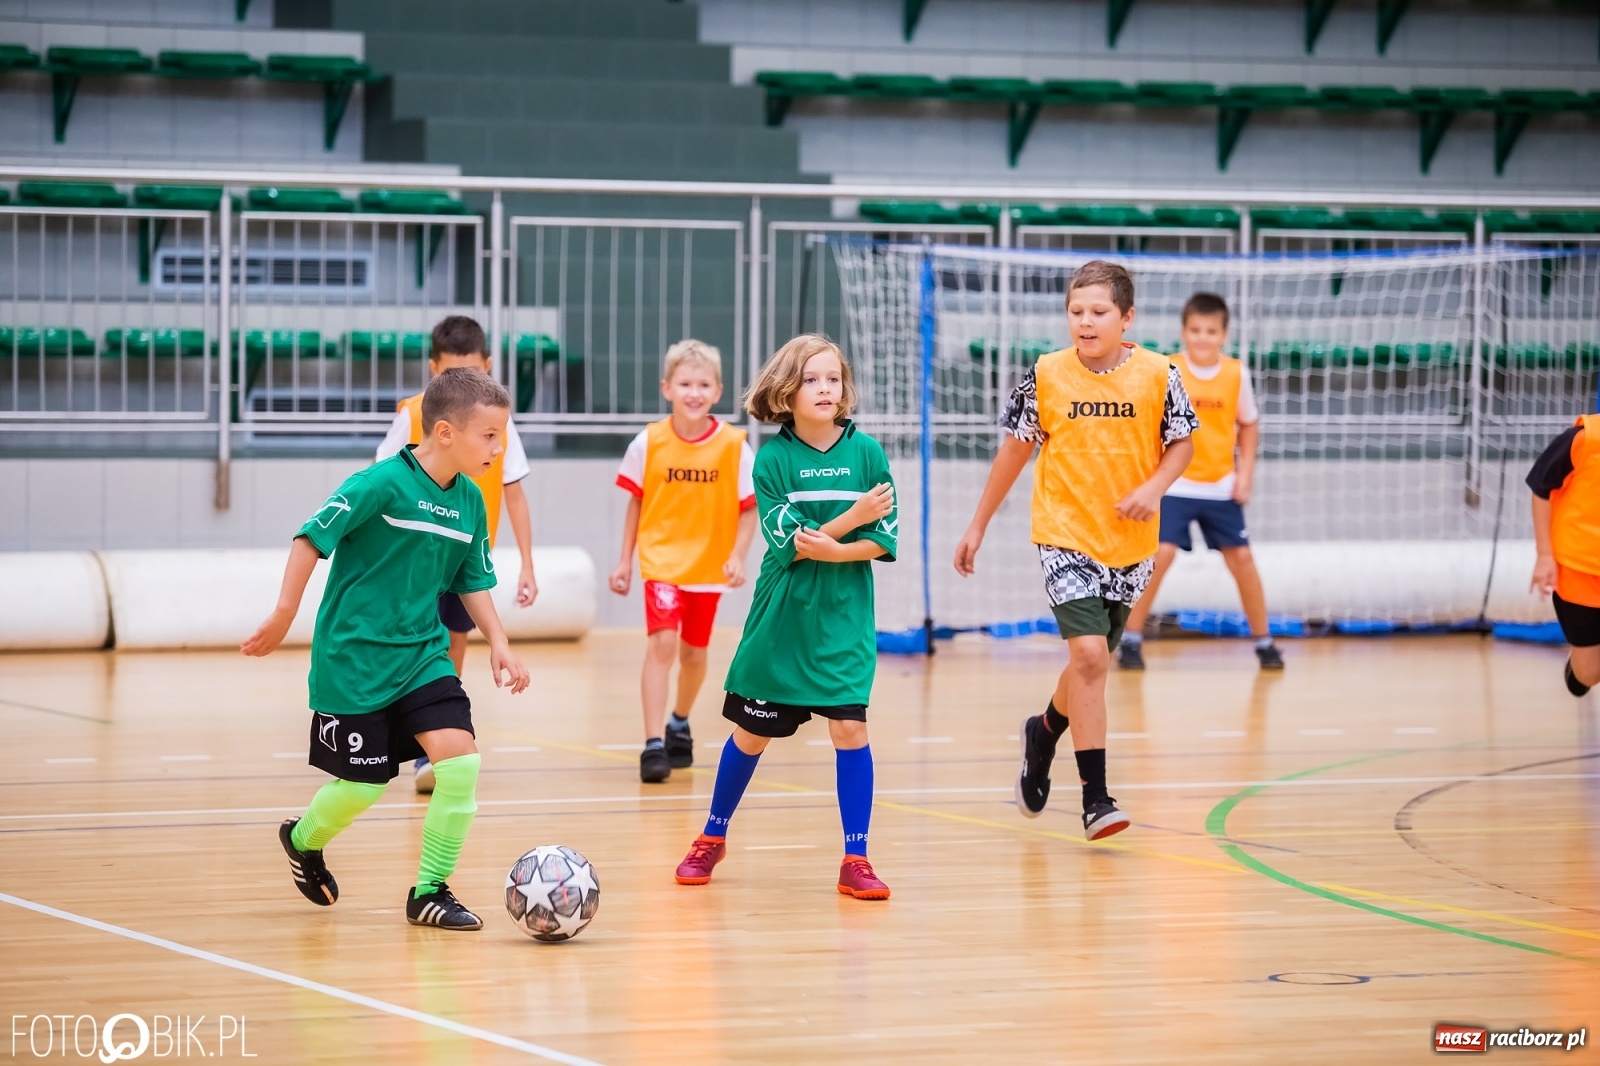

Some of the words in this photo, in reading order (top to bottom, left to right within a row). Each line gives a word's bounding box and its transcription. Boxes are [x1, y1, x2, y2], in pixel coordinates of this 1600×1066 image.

[799, 466, 851, 478] GIVOVA
[417, 499, 460, 520] GIVOVA
[347, 732, 364, 753] 9
